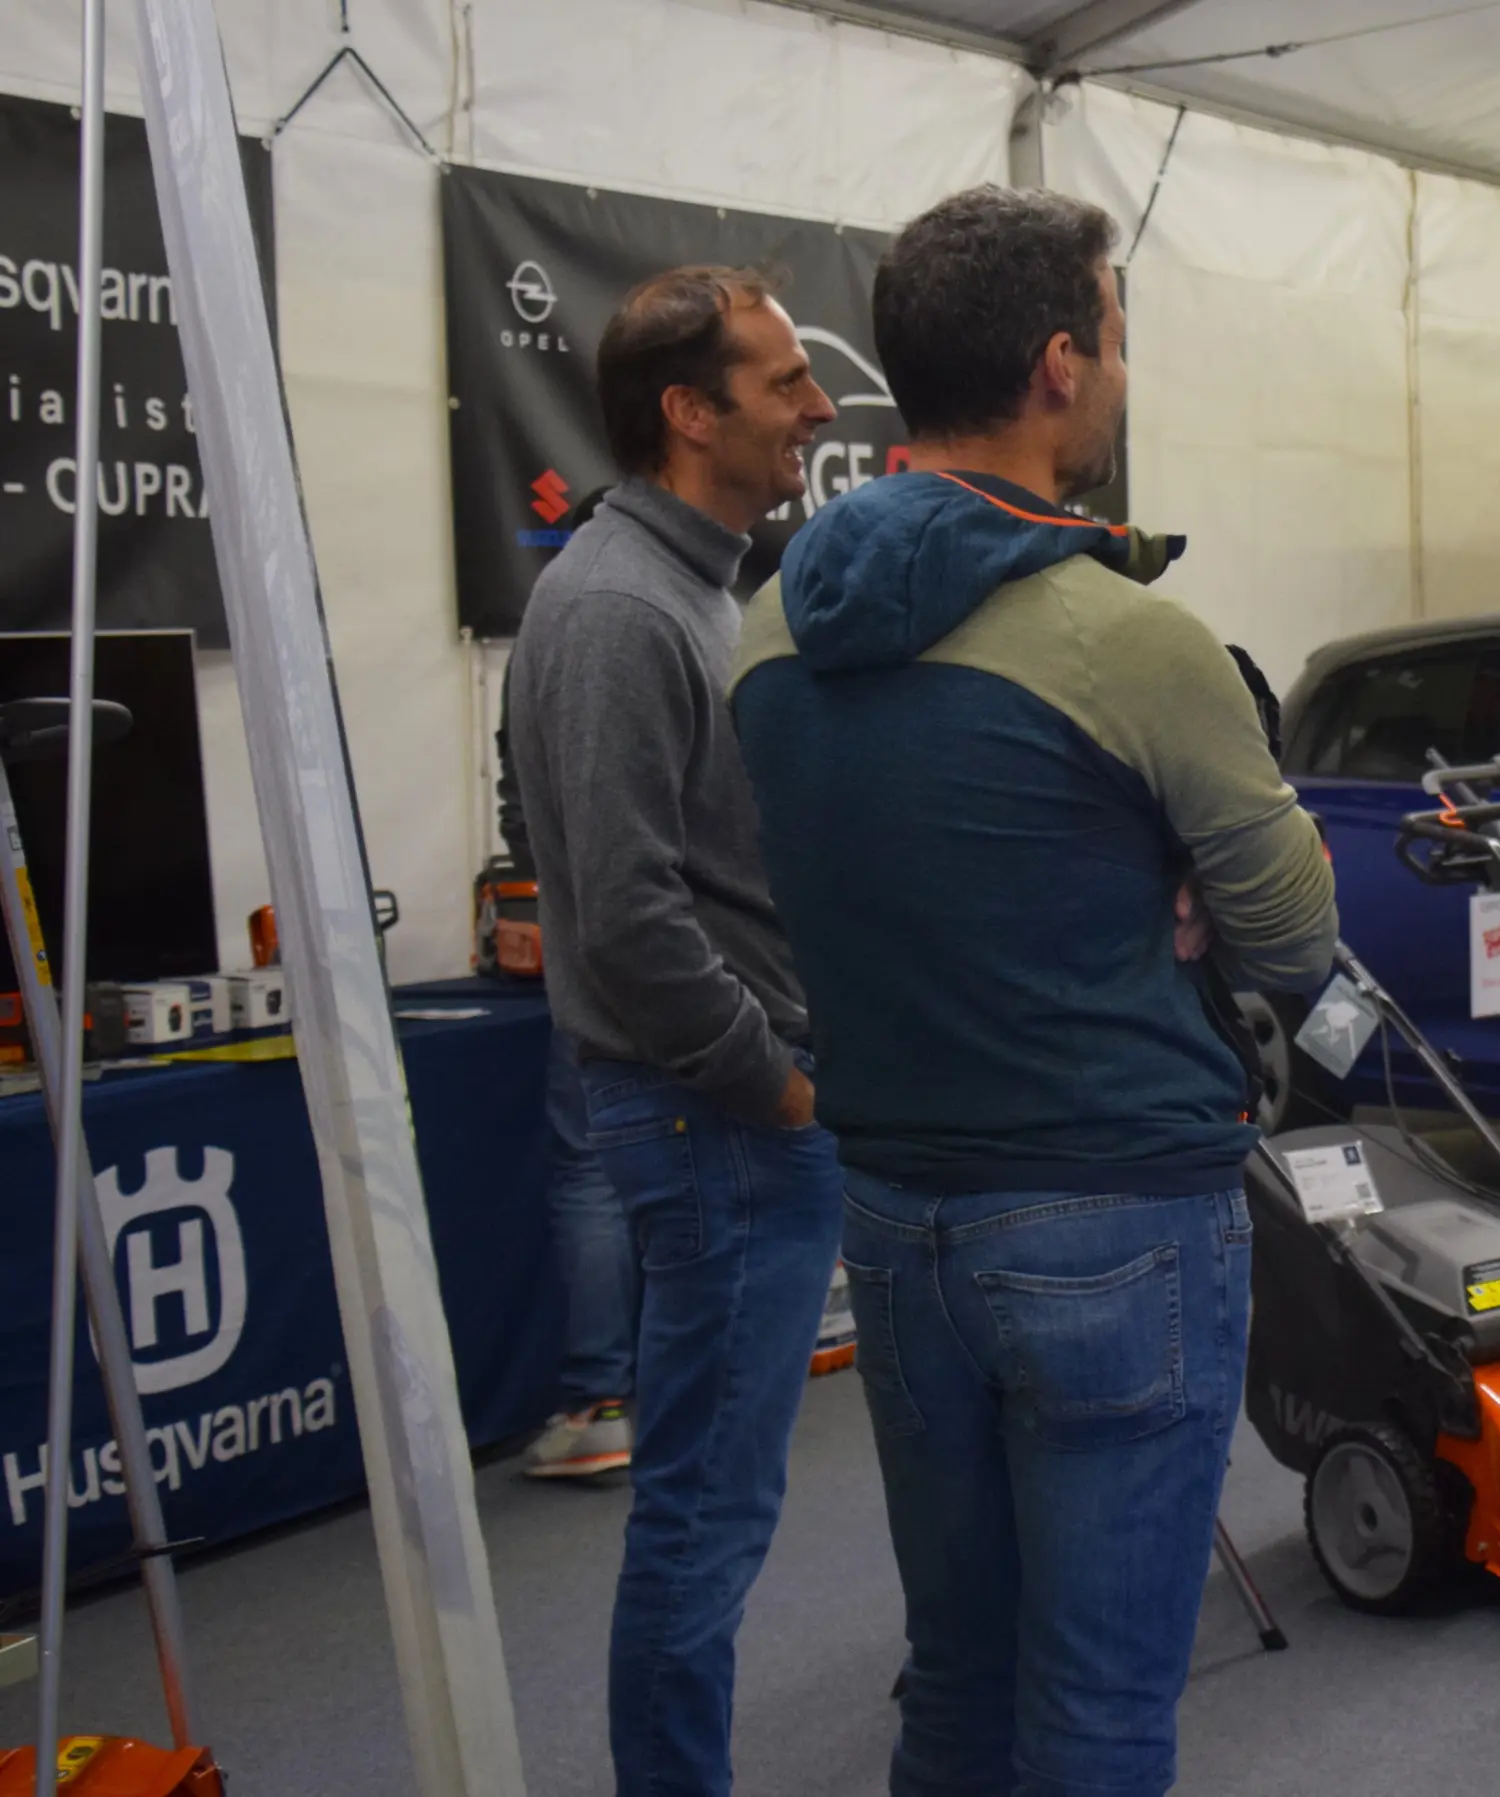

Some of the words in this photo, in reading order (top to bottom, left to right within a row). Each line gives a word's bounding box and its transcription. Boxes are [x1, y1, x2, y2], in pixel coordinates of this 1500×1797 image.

[500, 329, 570, 353] OPEL
[46, 457, 210, 519] CUPR
[3, 1377, 336, 1526] Husqvarna
